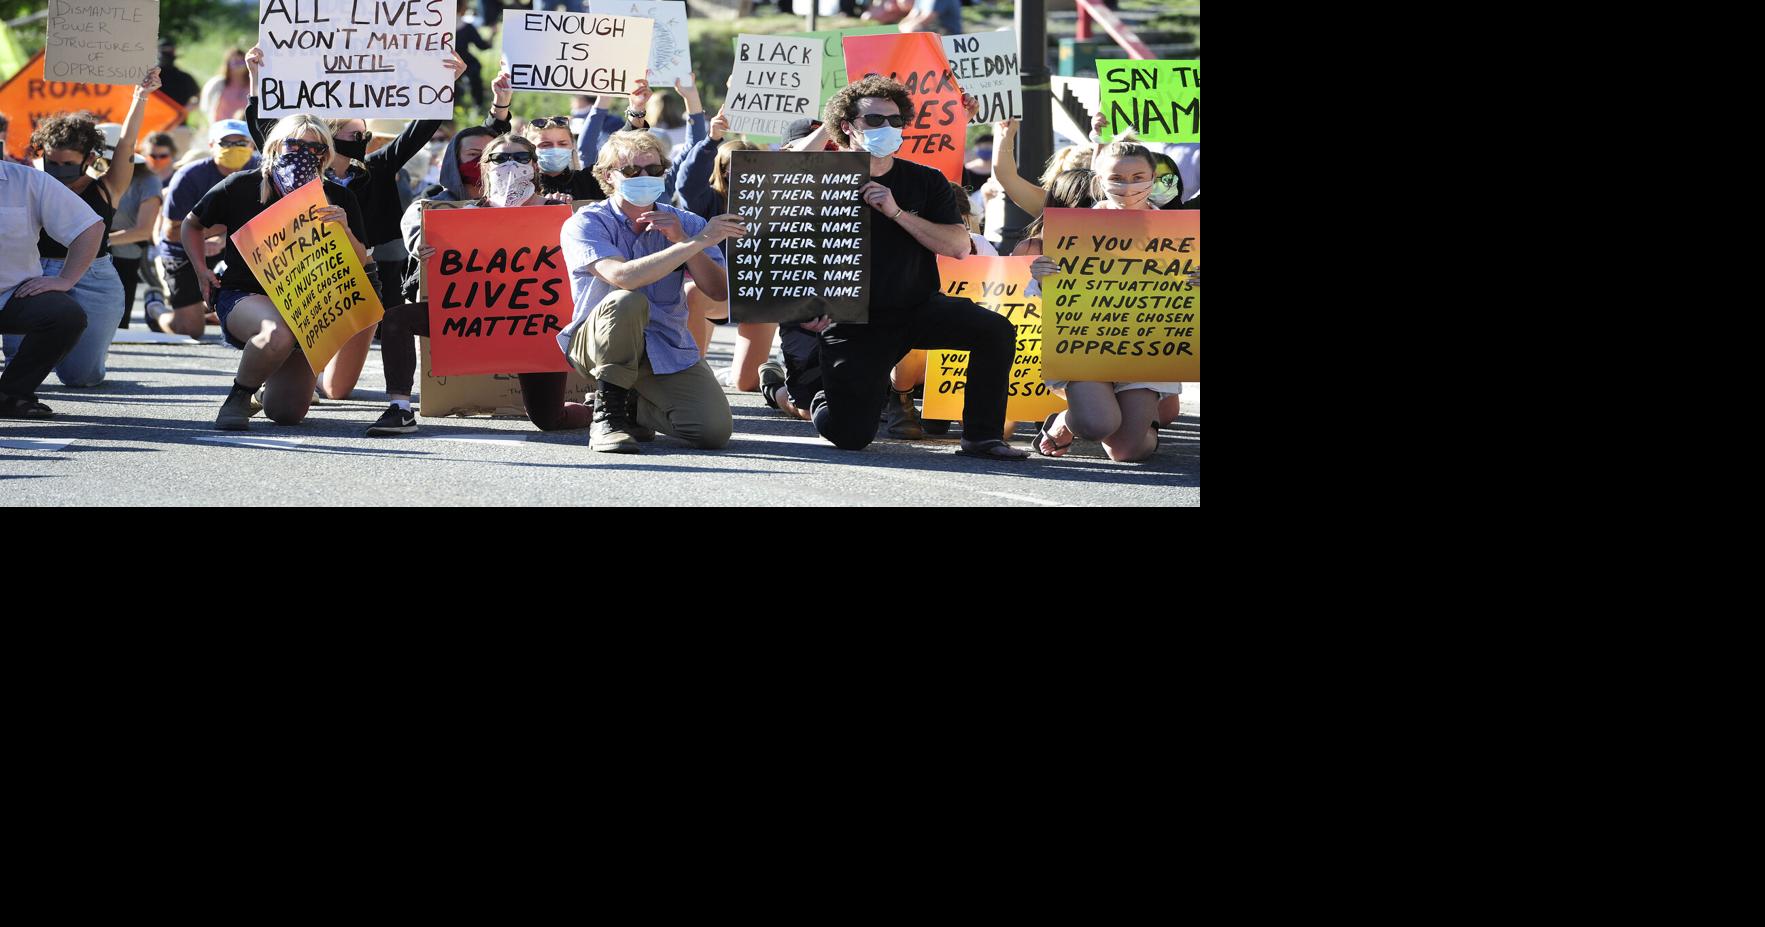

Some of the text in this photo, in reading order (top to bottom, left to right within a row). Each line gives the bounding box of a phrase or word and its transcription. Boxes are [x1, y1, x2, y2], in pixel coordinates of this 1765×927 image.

[260, 0, 443, 26] ALL LIVES
[52, 17, 112, 34] POWER
[525, 13, 626, 38] ENOUGH
[52, 33, 145, 52] STRUCTURES
[268, 28, 453, 51] WON'T MATTER
[953, 37, 979, 53] NO
[88, 53, 104, 62] OF
[556, 42, 589, 61] IS
[740, 42, 812, 64] BLACK
[53, 62, 150, 79] OPPRESSION
[323, 54, 395, 71] UNTIL
[948, 53, 1018, 80] REEDOM
[511, 64, 626, 92] ENOUGH
[746, 70, 801, 88] LIVES
[1106, 67, 1158, 93] SAY
[28, 79, 112, 99] ROAD
[262, 78, 454, 110] BLACK LIVES DO
[730, 92, 810, 114] MATTER
[968, 90, 1021, 124] UAL
[728, 114, 751, 131] TOP
[894, 134, 956, 154] TTER
[740, 173, 861, 187] SAY THEIR NAME
[739, 189, 859, 203] SAY THEIR NAME
[738, 206, 861, 220] SAY THEIR NAME
[252, 204, 318, 265] IF YOU ARE
[769, 222, 815, 232] THEIR
[822, 222, 861, 233] NAME
[263, 222, 332, 285] NEUTRAL
[736, 238, 862, 252] SAY THEIR NAME
[1057, 235, 1195, 253] IF YOU ARE
[275, 240, 337, 296] IN SITUATIONS
[440, 246, 562, 276] BLACK
[736, 254, 863, 268] SAY THEIR NAME
[1058, 256, 1195, 276] NEUTRAL
[284, 252, 344, 311] OF INJUSTICE
[737, 270, 862, 284] SAY THEIR NAME
[1056, 279, 1194, 292] IN SITUATIONS
[291, 266, 350, 323] YOU HAVE CHOSEN
[441, 278, 562, 310] LIVES
[738, 286, 862, 300] SAY THEIR NAME
[948, 281, 1017, 297] IF YOU
[298, 278, 357, 333] THE SIDE OF THE
[1056, 294, 1195, 309] OF INJUSTICE
[306, 291, 366, 349] OPPRESSOR
[442, 314, 563, 338] MATTER
[1056, 312, 1195, 324] YOU HAVE CHOSEN
[1056, 326, 1194, 337] THE SIDE OF THE
[1056, 340, 1194, 356] OPPRESSOR
[941, 353, 1042, 365] YOU CHO
[1014, 369, 1031, 378] OF
